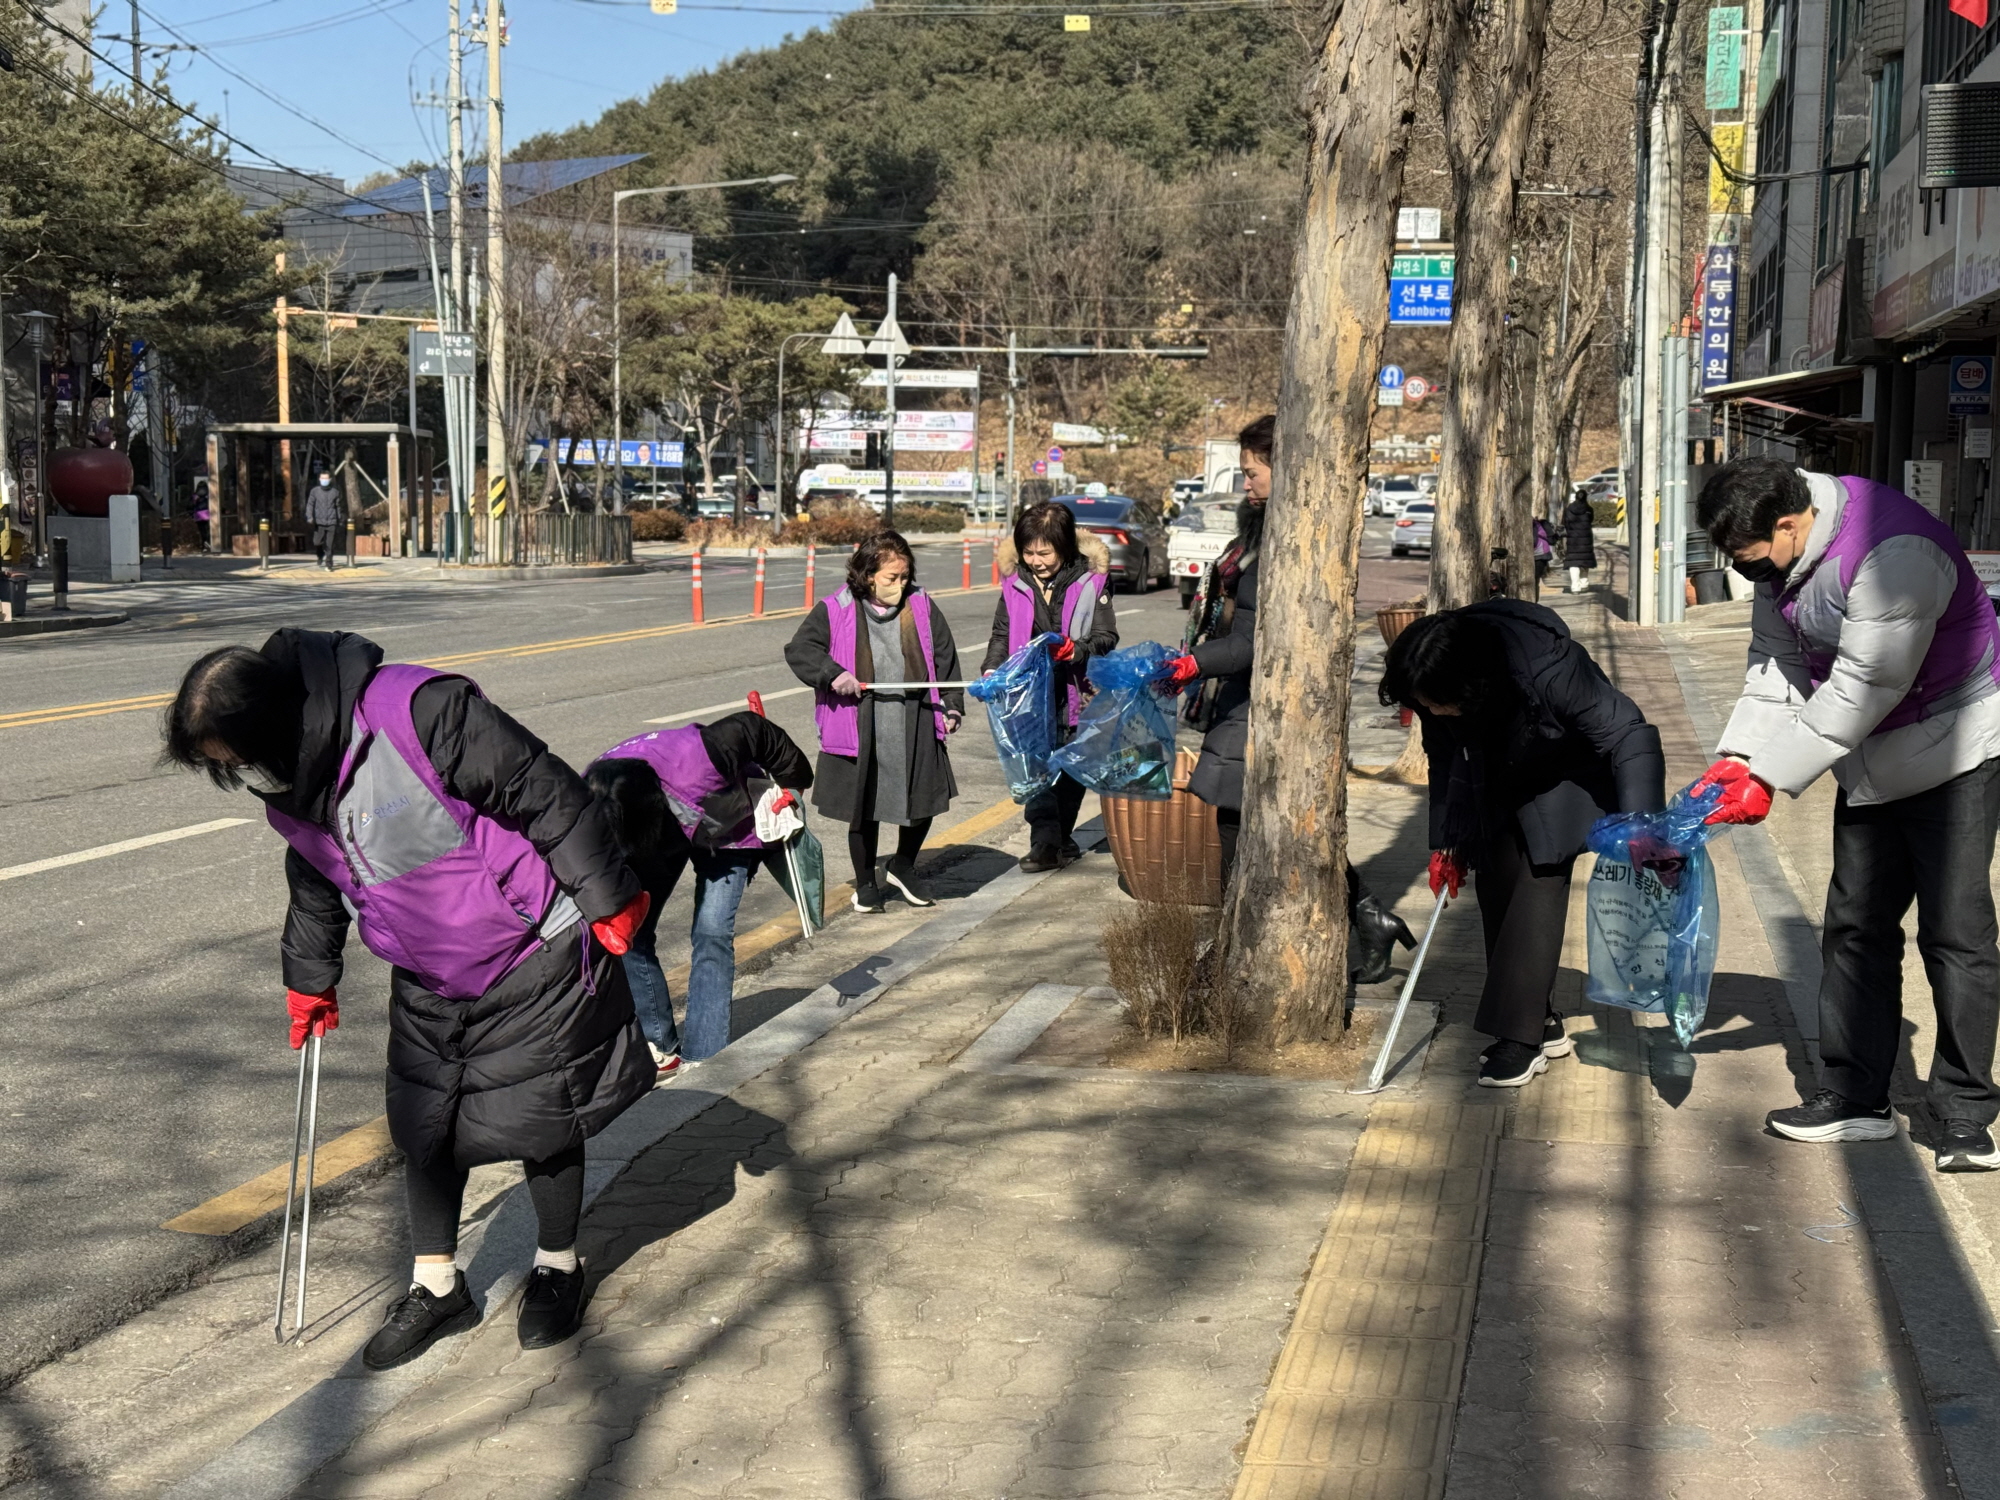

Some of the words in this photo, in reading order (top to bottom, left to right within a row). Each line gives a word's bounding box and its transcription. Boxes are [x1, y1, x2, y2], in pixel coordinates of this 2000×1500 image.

[1400, 284, 1451, 303] 선부로
[1398, 304, 1451, 317] Seonbu-ro
[1706, 253, 1733, 379] 와동한의원
[1960, 368, 1984, 379] 담배
[1409, 382, 1422, 394] 30
[1200, 543, 1220, 551] KIA
[374, 795, 411, 819] 안산시
